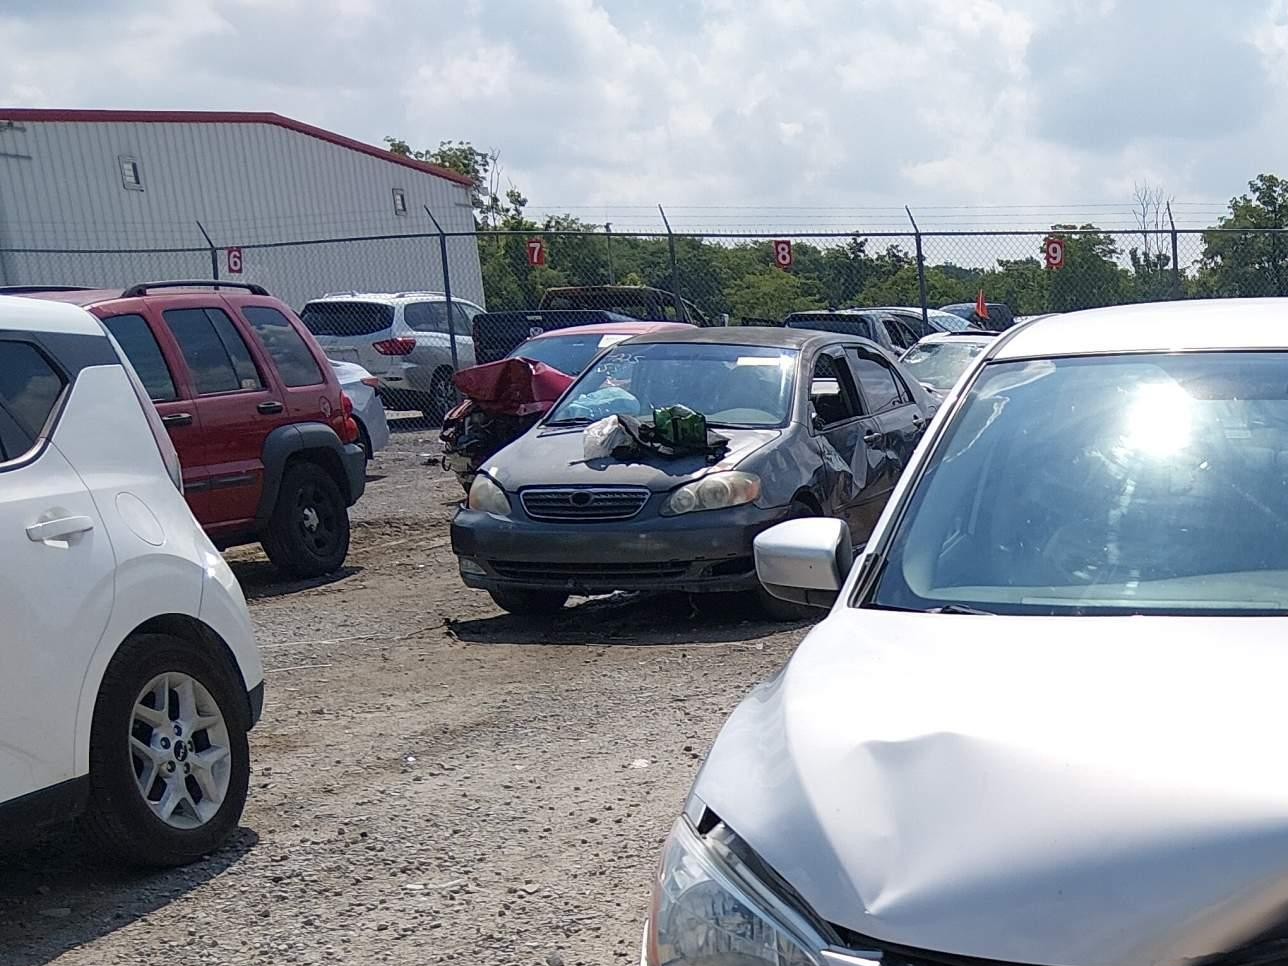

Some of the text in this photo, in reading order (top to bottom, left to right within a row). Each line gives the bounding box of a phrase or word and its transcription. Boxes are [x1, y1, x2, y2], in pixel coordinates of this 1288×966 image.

[229, 251, 241, 271] 6
[529, 242, 541, 264] 7
[777, 244, 791, 265] 8
[1048, 244, 1062, 265] 9
